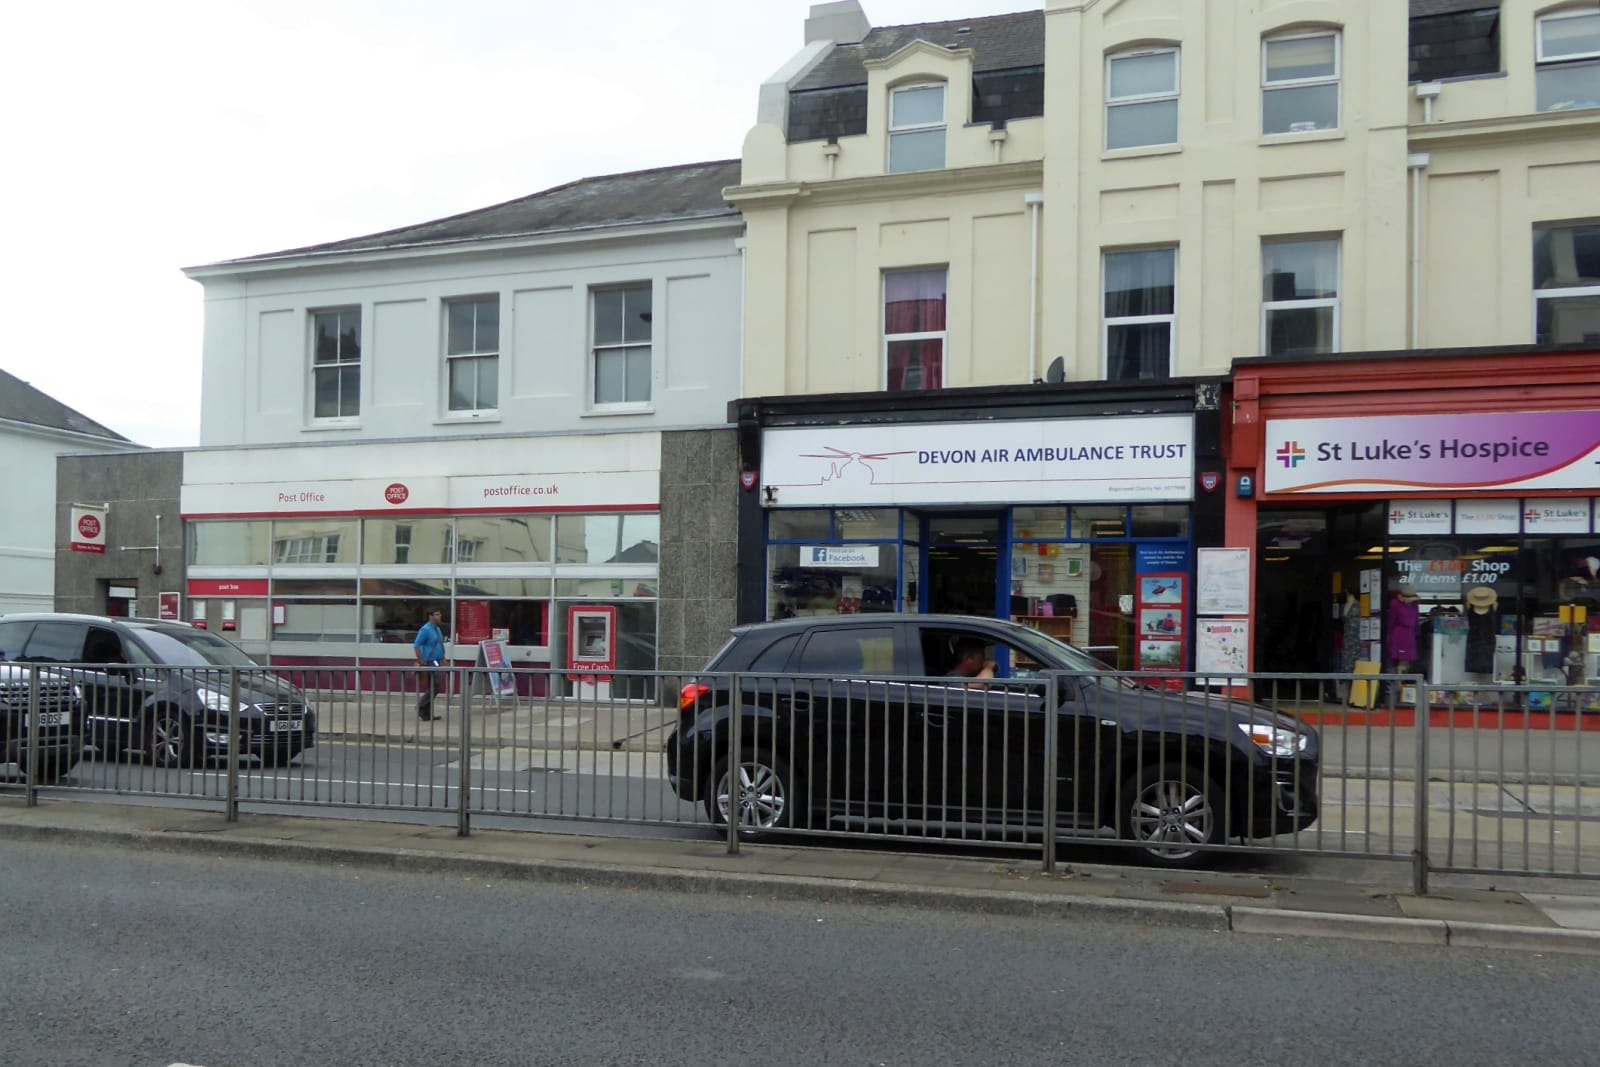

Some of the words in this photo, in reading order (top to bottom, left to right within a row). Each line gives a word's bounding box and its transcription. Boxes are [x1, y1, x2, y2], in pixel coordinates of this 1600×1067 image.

[917, 449, 977, 465] DEVON
[980, 448, 1010, 464] AIR
[1013, 445, 1125, 462] AMBULANCE
[1128, 443, 1188, 460] TRUST
[1316, 441, 1343, 462] St
[1350, 438, 1432, 461] Luke's
[1439, 436, 1550, 463] Hospice
[483, 484, 559, 499] postoffice.co.uk
[279, 492, 297, 502] Post
[299, 492, 325, 502] Office
[1407, 510, 1418, 519] St
[1419, 510, 1449, 519] Luke's
[1543, 509, 1554, 518] St
[1556, 508, 1587, 518] Luke's
[82, 518, 97, 526] POST
[79, 525, 98, 534] OFFICE
[828, 552, 865, 561] Facebook
[1394, 560, 1423, 572] The
[1471, 560, 1510, 574] Shop
[1398, 573, 1416, 583] all
[1419, 573, 1457, 583] items
[1461, 573, 1498, 584] £1.00
[573, 662, 589, 671] Free
[591, 663, 610, 671] Cash
